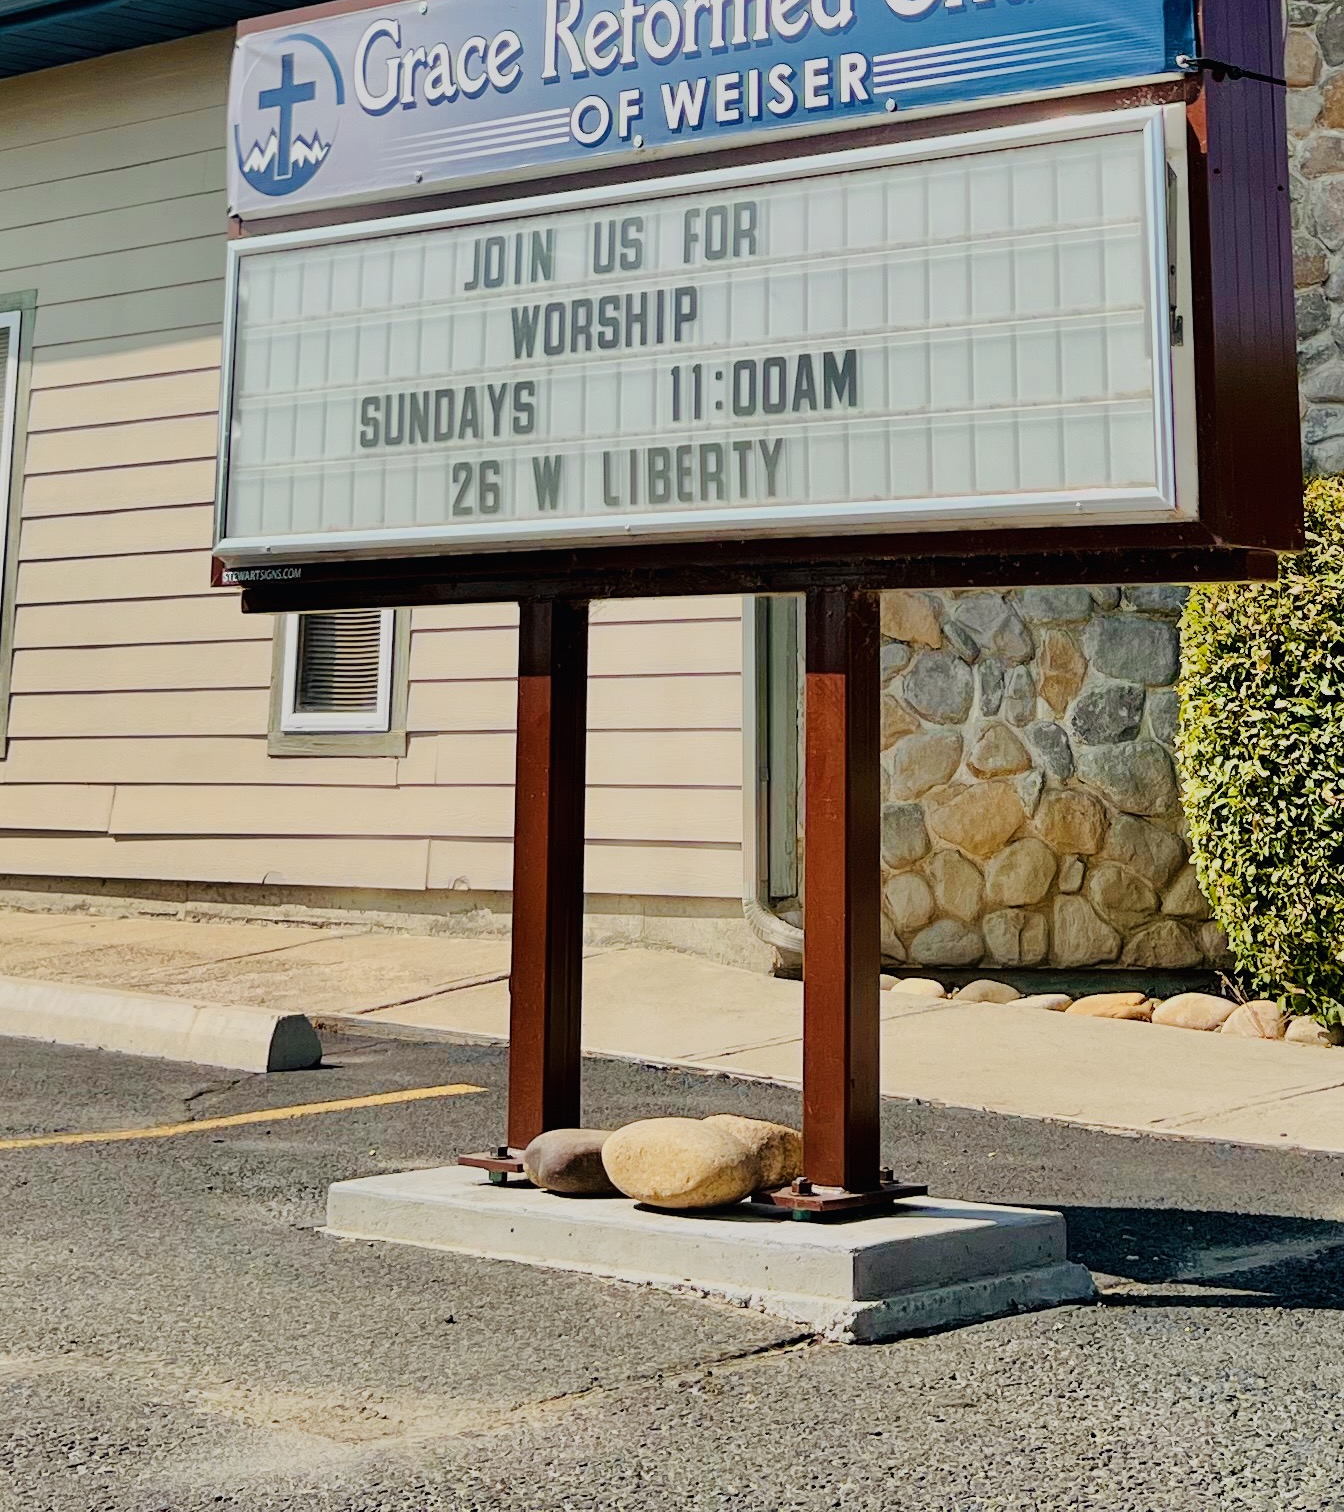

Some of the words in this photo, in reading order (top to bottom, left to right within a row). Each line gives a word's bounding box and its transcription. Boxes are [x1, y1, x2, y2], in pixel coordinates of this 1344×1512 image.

[353, 18, 522, 113] Grace
[570, 88, 642, 146] OF
[660, 51, 869, 131] WEISER
[464, 228, 553, 290] JOIN
[593, 216, 644, 274] US
[683, 200, 757, 264] FOR
[511, 285, 697, 359] WORSHIP
[359, 380, 535, 448] SUNDAYS
[670, 349, 857, 422] 11:00AM
[452, 460, 501, 516] 26
[532, 454, 562, 511] W
[603, 438, 784, 506] LIBERTY
[222, 568, 302, 583] STEWARTSIGNS.COM
